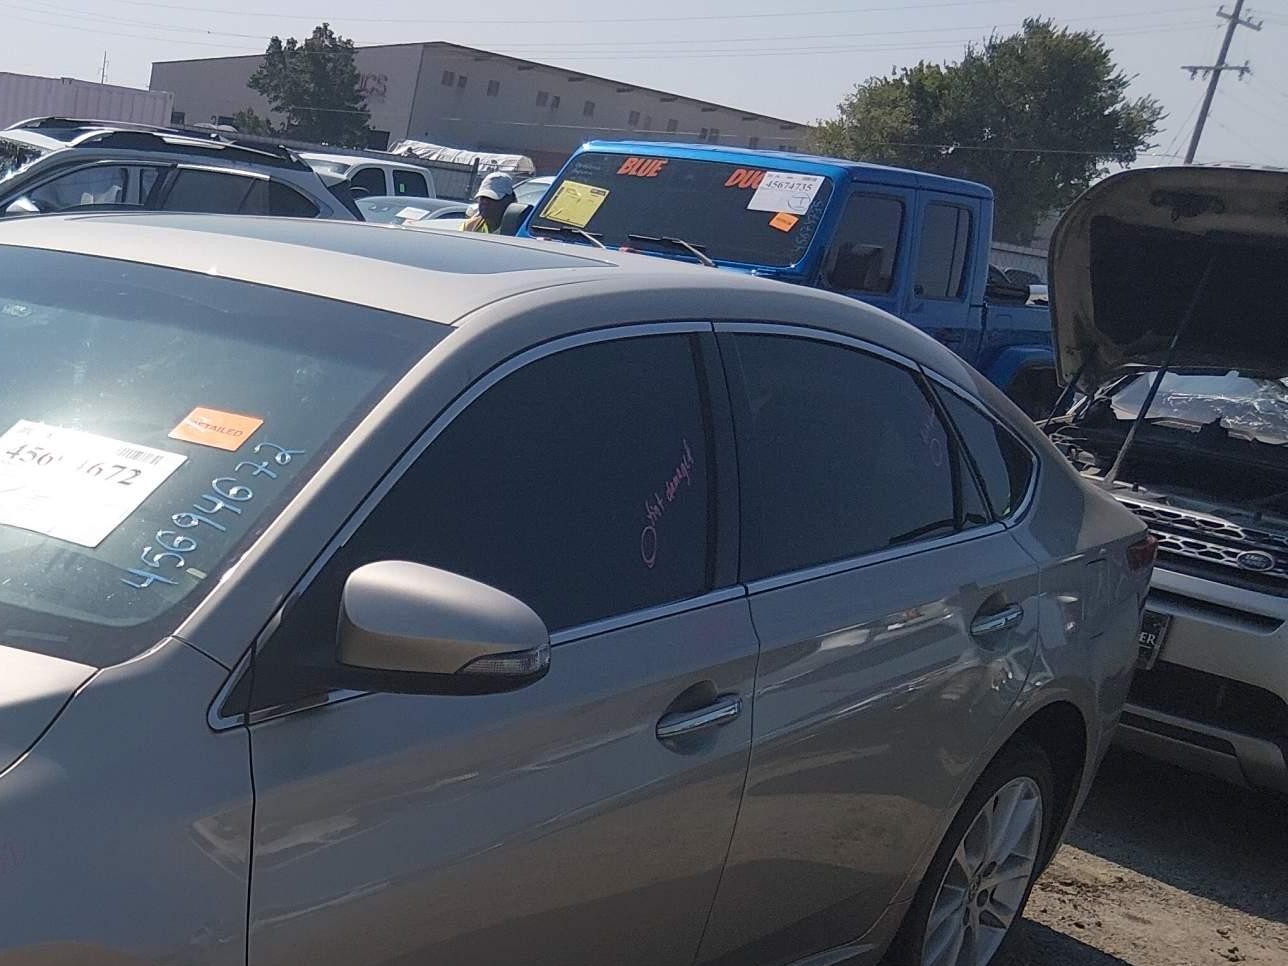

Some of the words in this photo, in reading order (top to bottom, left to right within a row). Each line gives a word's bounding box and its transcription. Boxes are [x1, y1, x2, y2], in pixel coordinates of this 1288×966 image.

[616, 157, 669, 177] BLUE
[766, 180, 814, 192] 45674735
[190, 419, 244, 437] TAILED
[5, 444, 142, 486] 456672
[120, 443, 304, 588] 45694672
